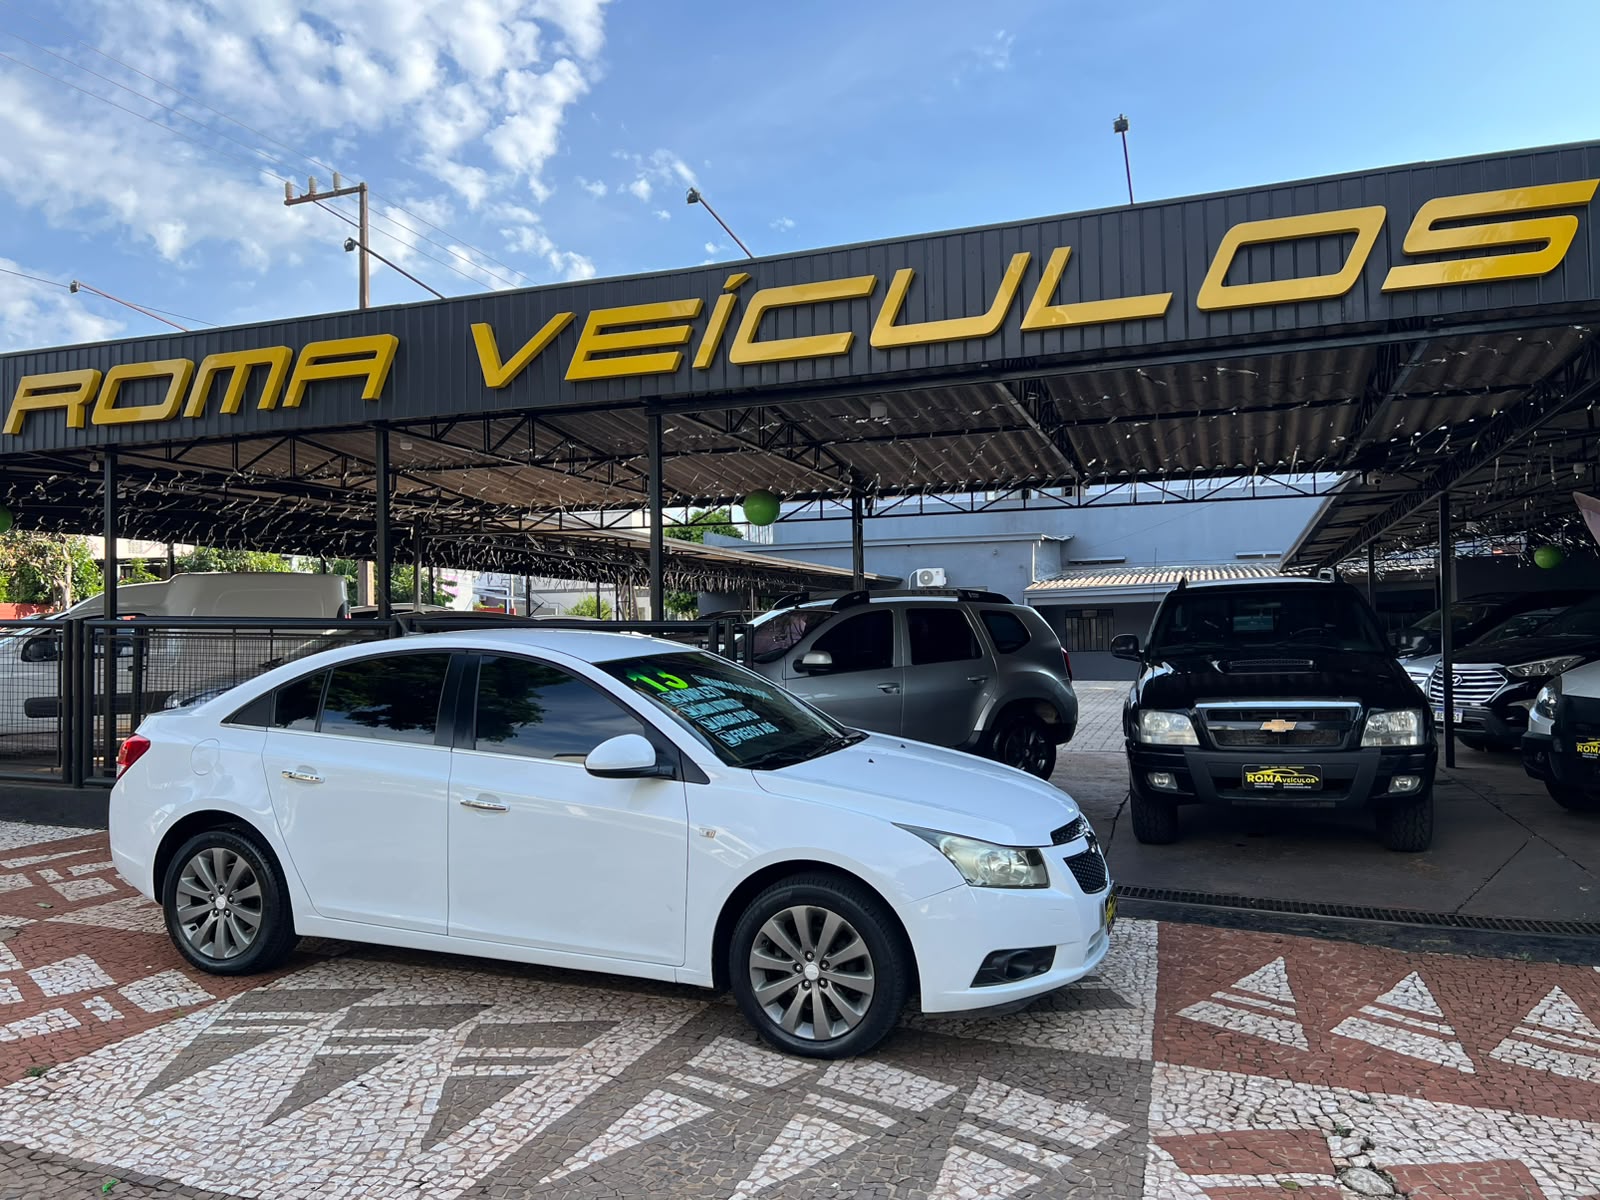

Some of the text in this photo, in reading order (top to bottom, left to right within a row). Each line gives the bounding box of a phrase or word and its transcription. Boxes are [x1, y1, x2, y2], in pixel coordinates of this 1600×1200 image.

[2, 179, 1600, 435] ROMA VEÍCULOS
[726, 724, 766, 742] FREIOS
[1576, 743, 1600, 754] ROM
[1247, 773, 1282, 783] ROMA
